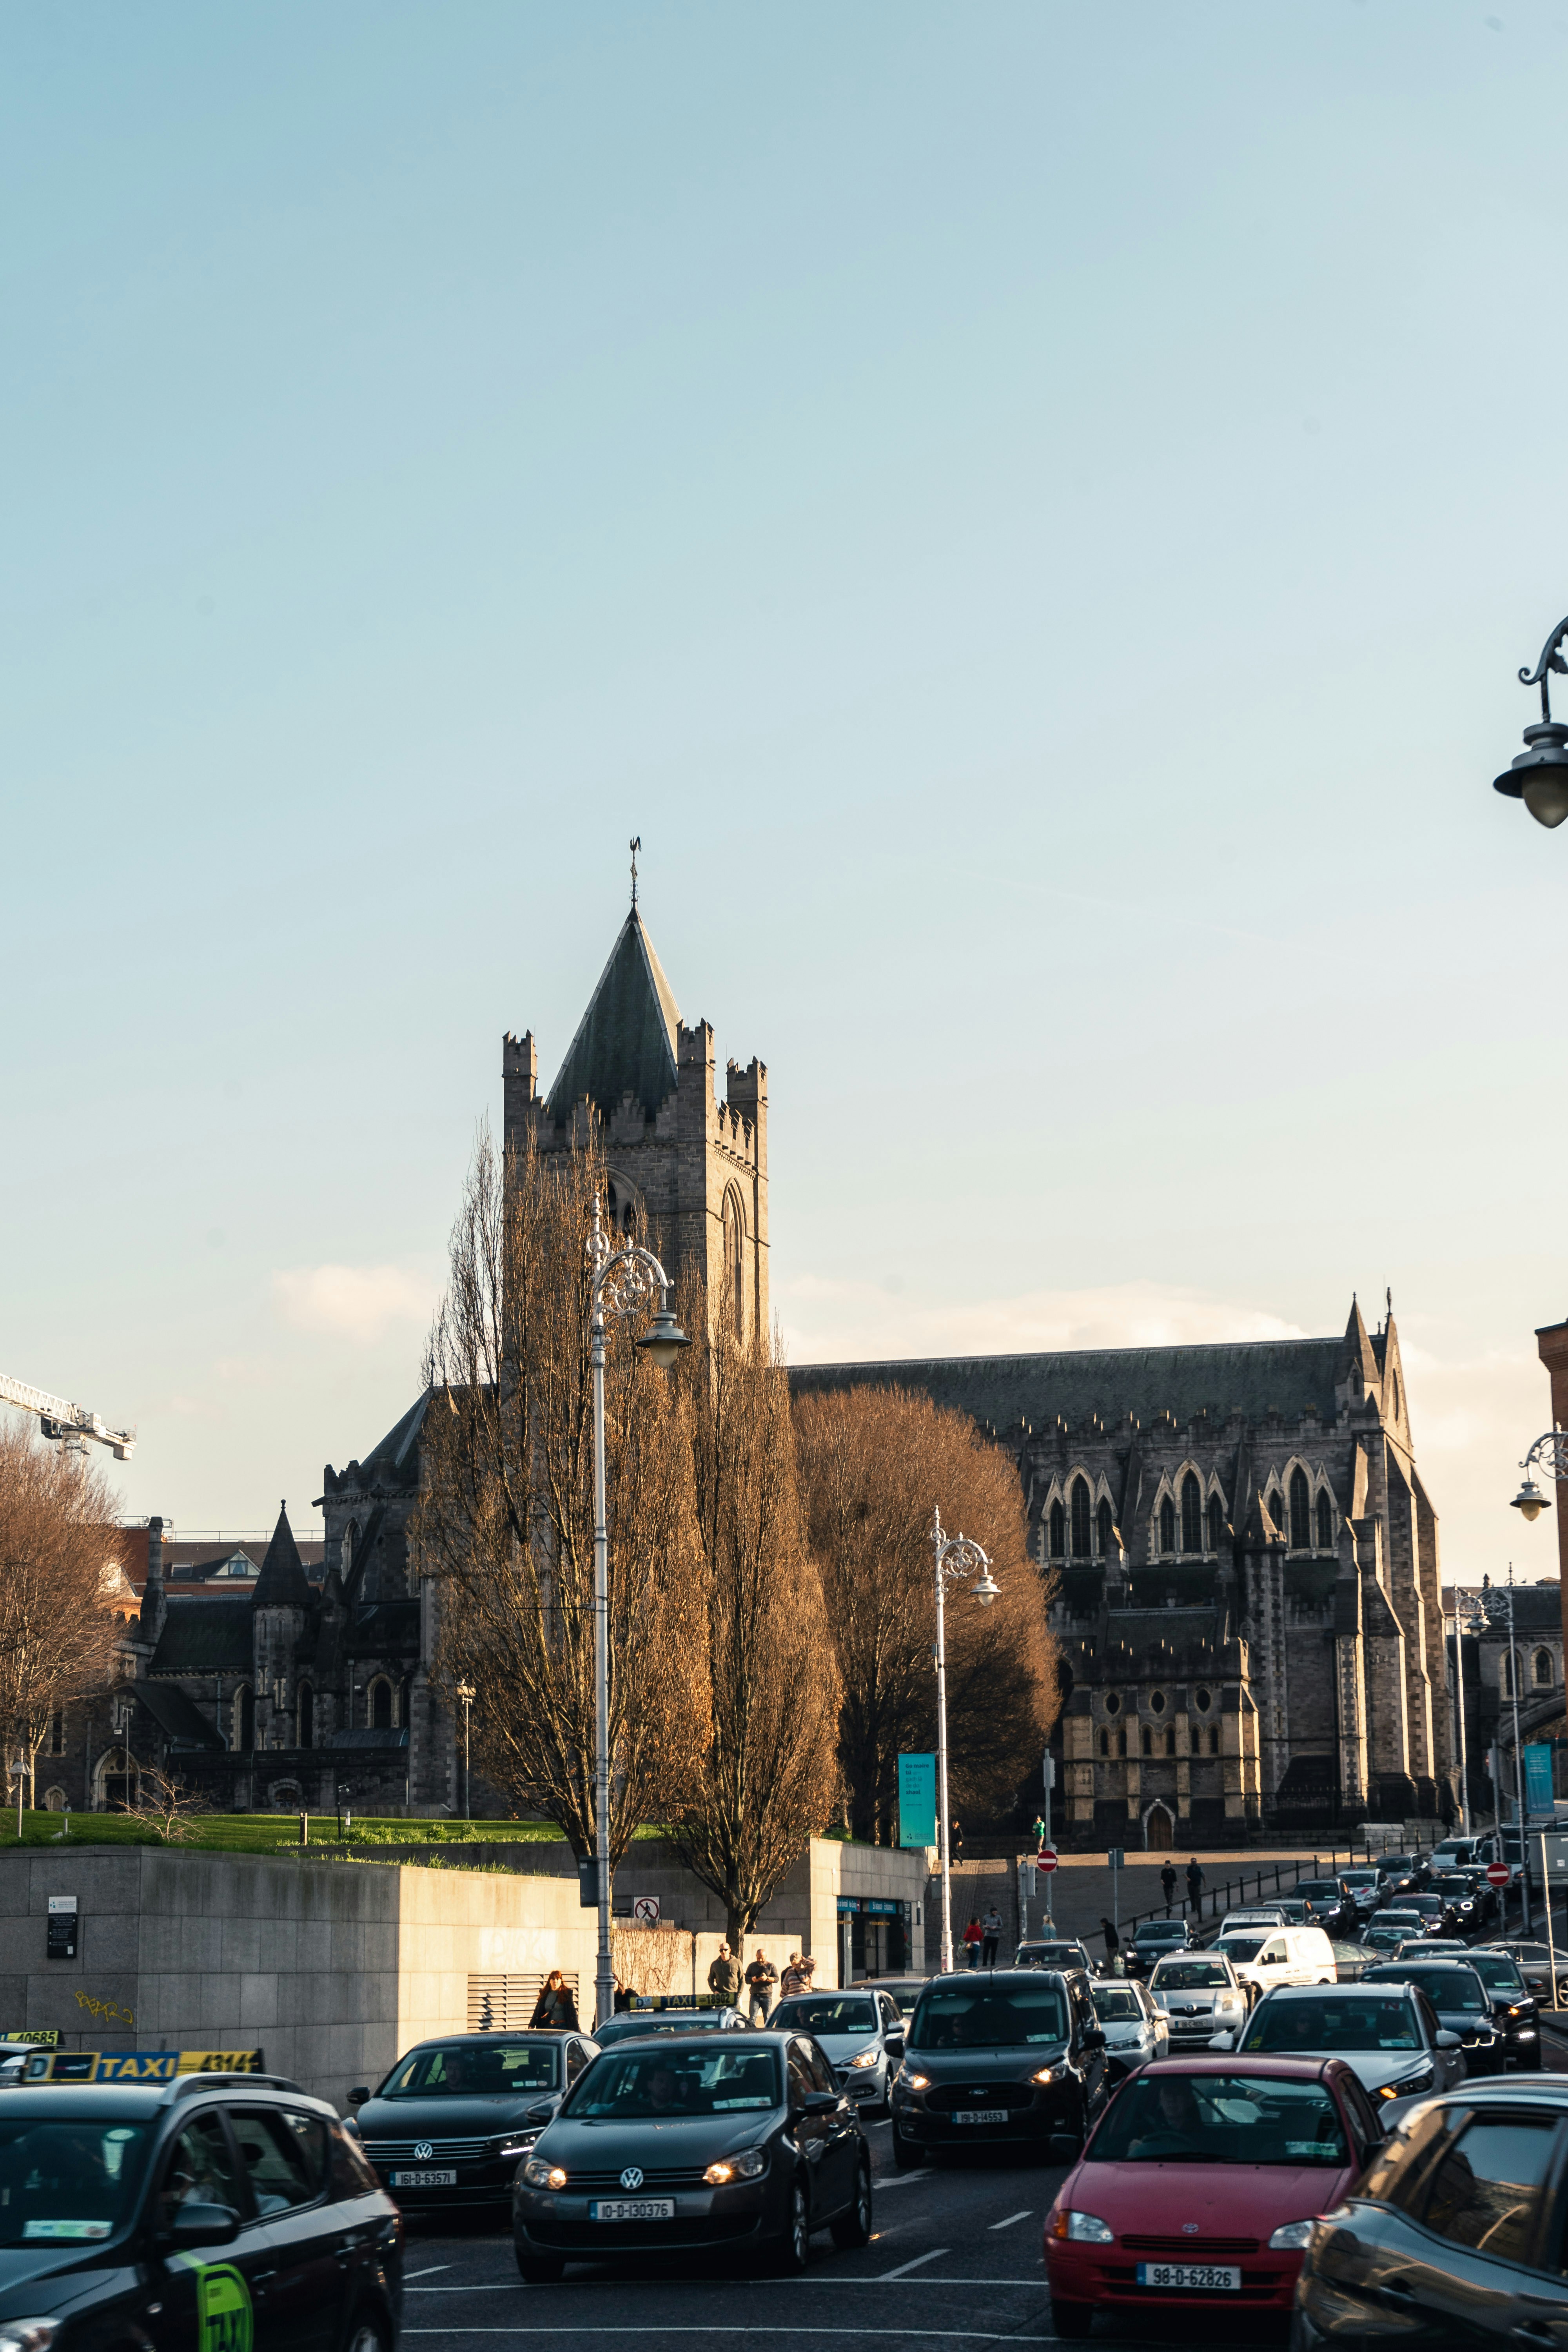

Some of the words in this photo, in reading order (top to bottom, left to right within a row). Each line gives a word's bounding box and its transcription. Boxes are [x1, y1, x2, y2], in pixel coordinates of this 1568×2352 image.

[666, 1996, 692, 2006] TAXI
[707, 1993, 730, 2004] 18902
[30, 2058, 47, 2077] D
[101, 2058, 176, 2077] TAXI
[400, 2172, 450, 2185] 161-D-63571
[601, 2203, 668, 2218] 10-D-130376
[1154, 2267, 1232, 2287] 98-D-62826
